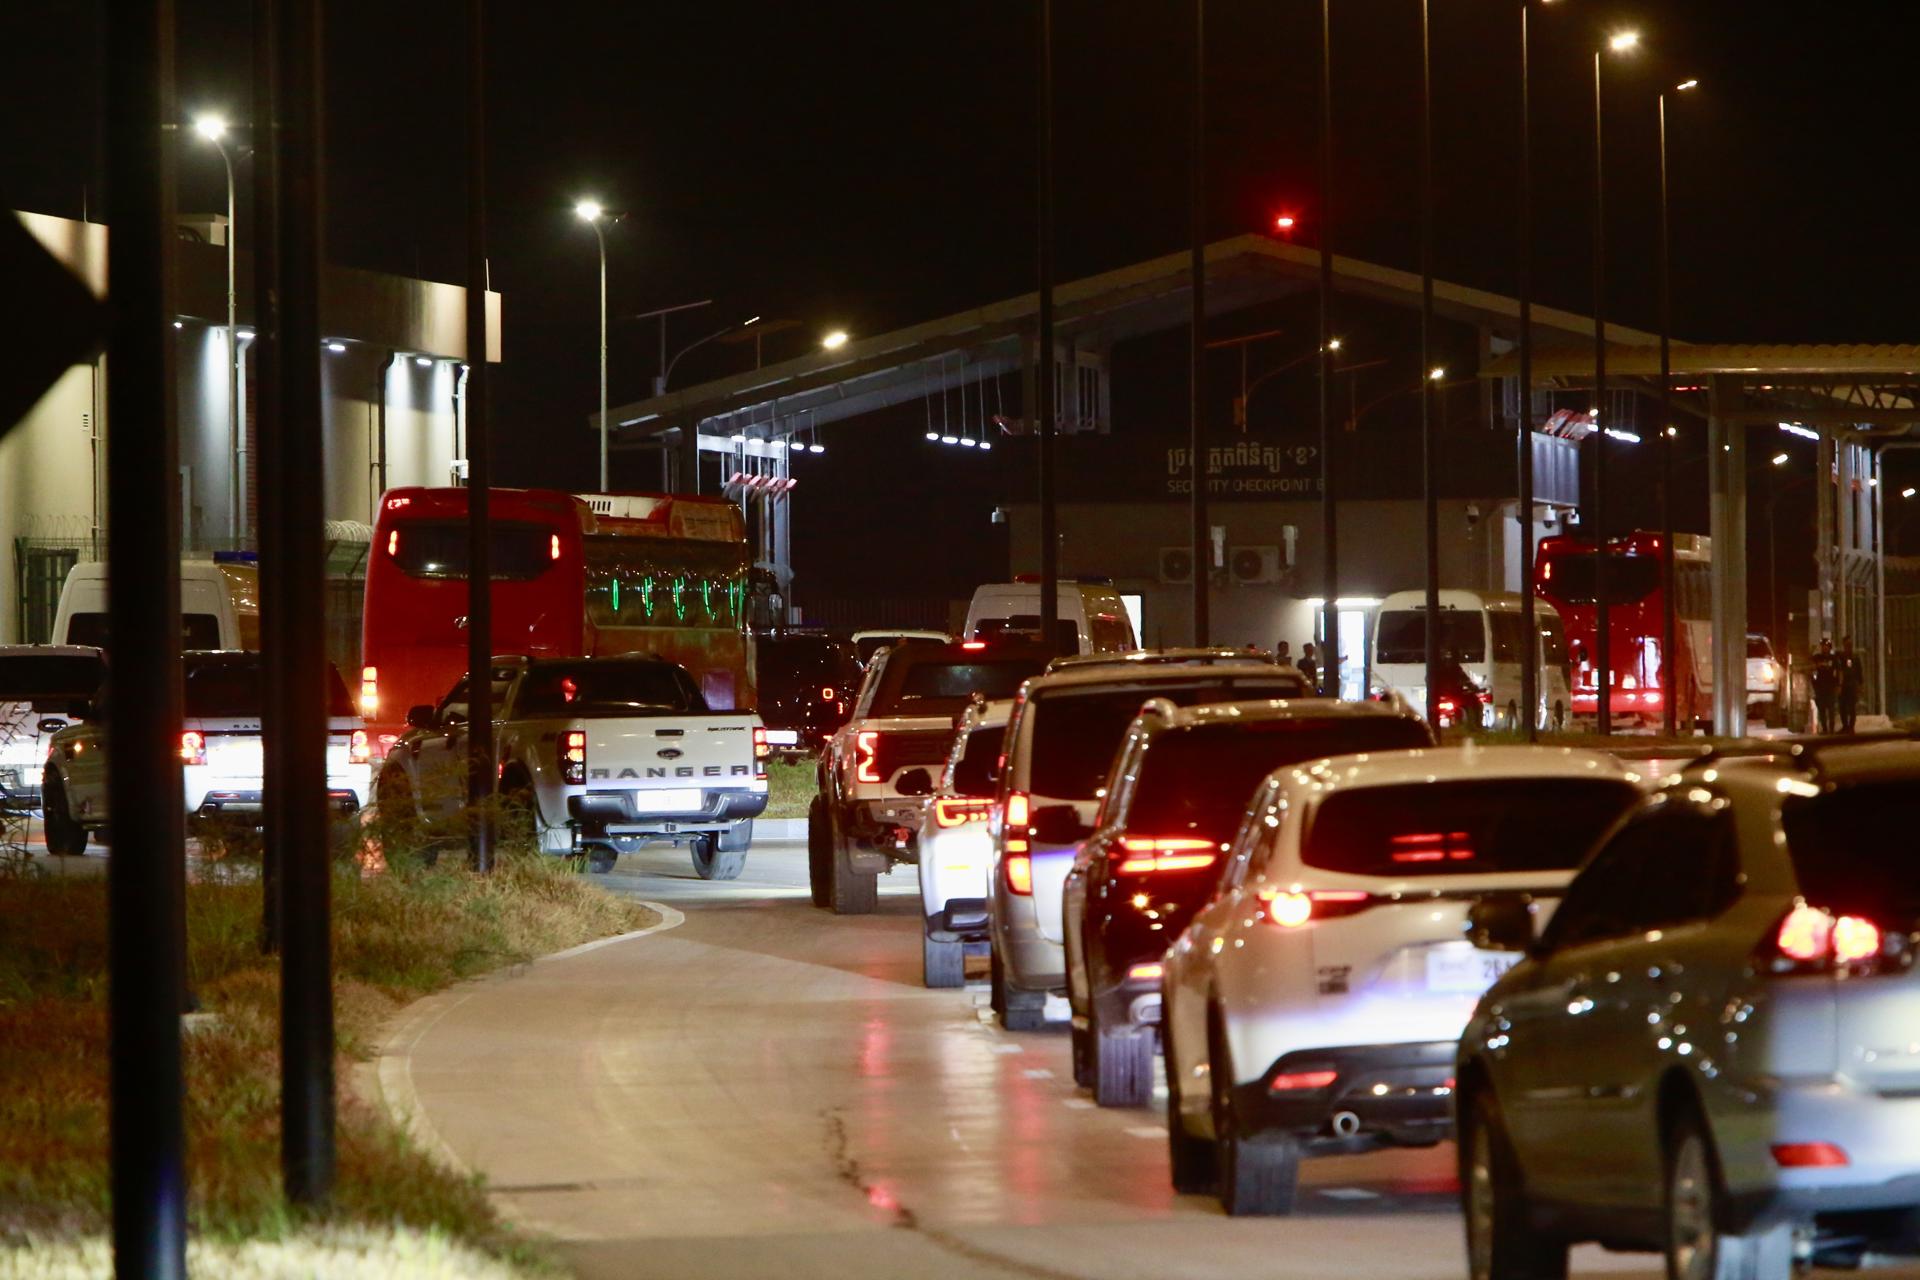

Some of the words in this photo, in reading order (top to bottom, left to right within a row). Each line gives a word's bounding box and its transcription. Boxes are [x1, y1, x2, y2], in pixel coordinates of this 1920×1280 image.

[1167, 479, 1229, 492] SECITY
[1232, 478, 1310, 492] CHECKPOINT
[590, 765, 749, 779] RANGER
